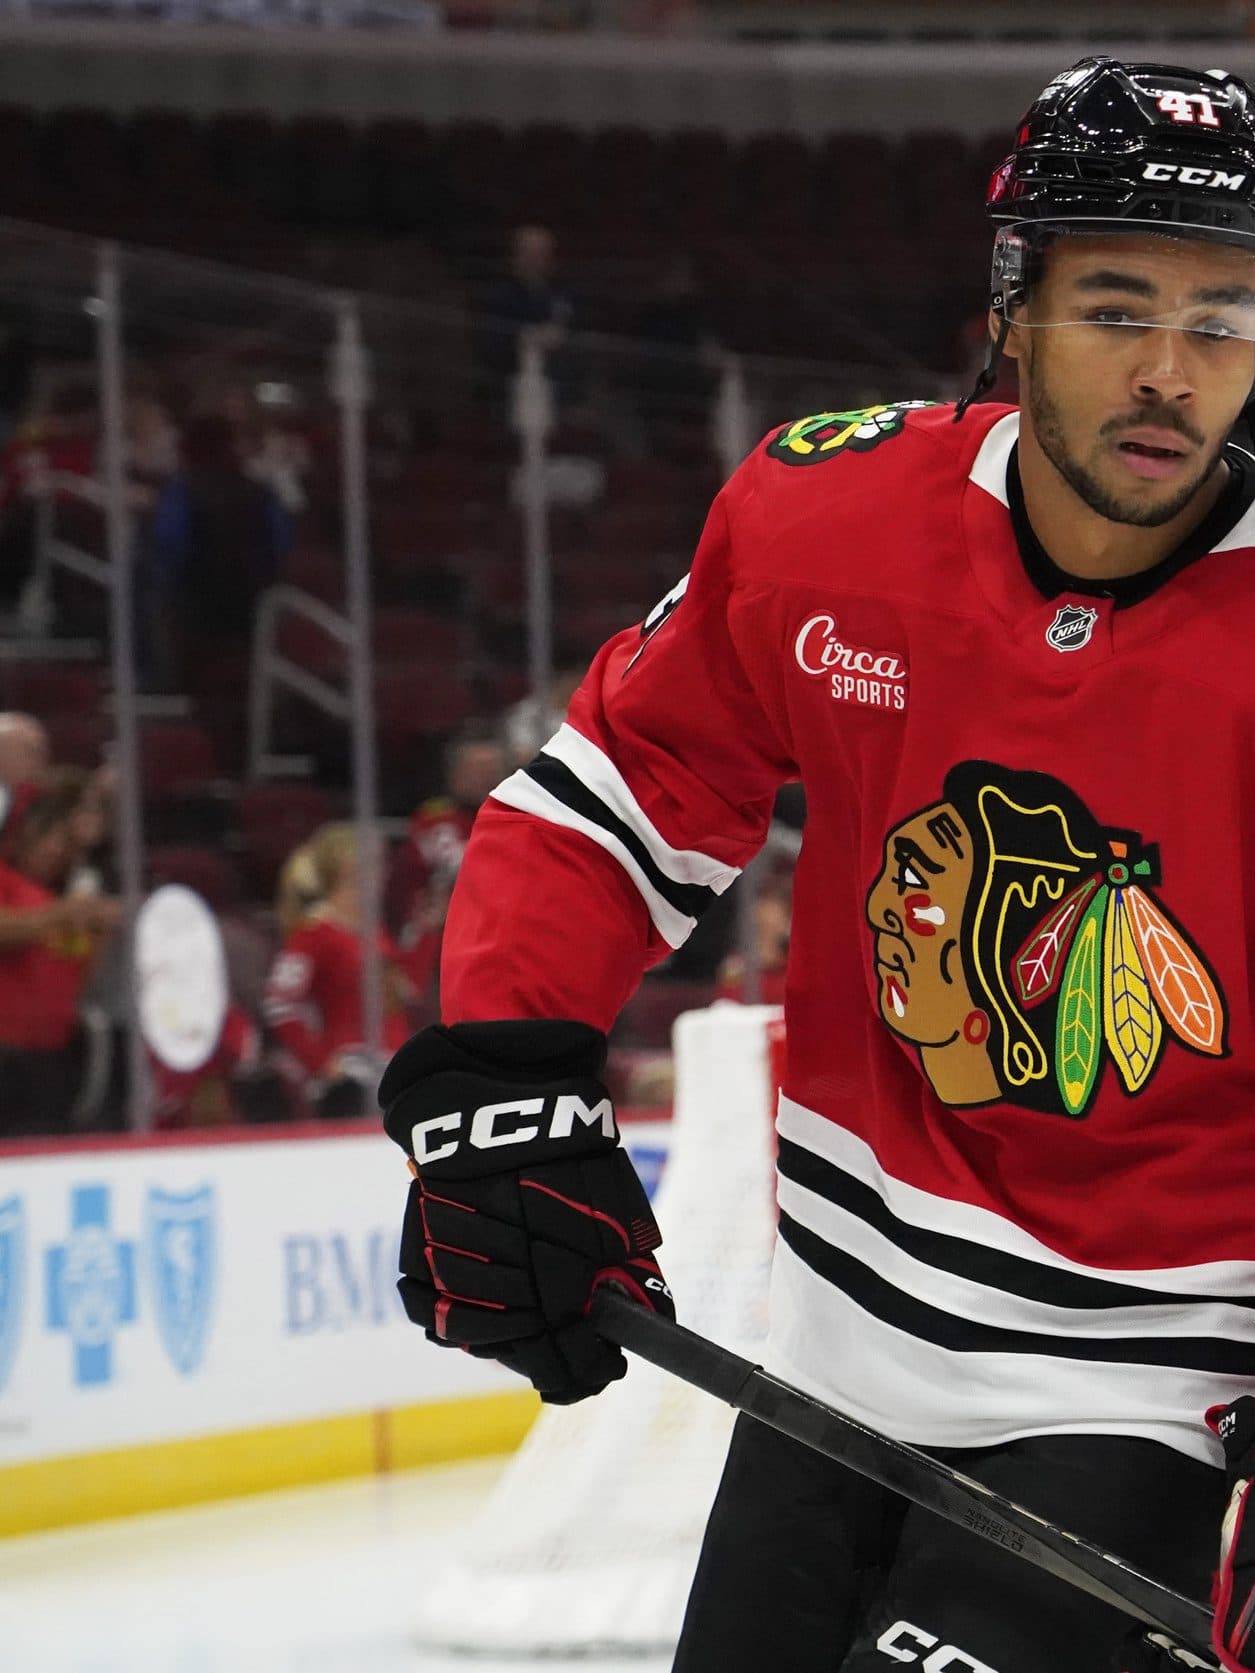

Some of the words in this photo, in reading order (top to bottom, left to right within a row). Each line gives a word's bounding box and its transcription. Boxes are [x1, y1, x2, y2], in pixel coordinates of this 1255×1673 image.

[1157, 90, 1221, 128] 41
[1142, 161, 1247, 191] CCM
[794, 614, 906, 680] Circa
[1055, 618, 1089, 640] NHL
[831, 673, 906, 710] SPORTS
[411, 1094, 616, 1166] CCM
[283, 1232, 401, 1336] BM
